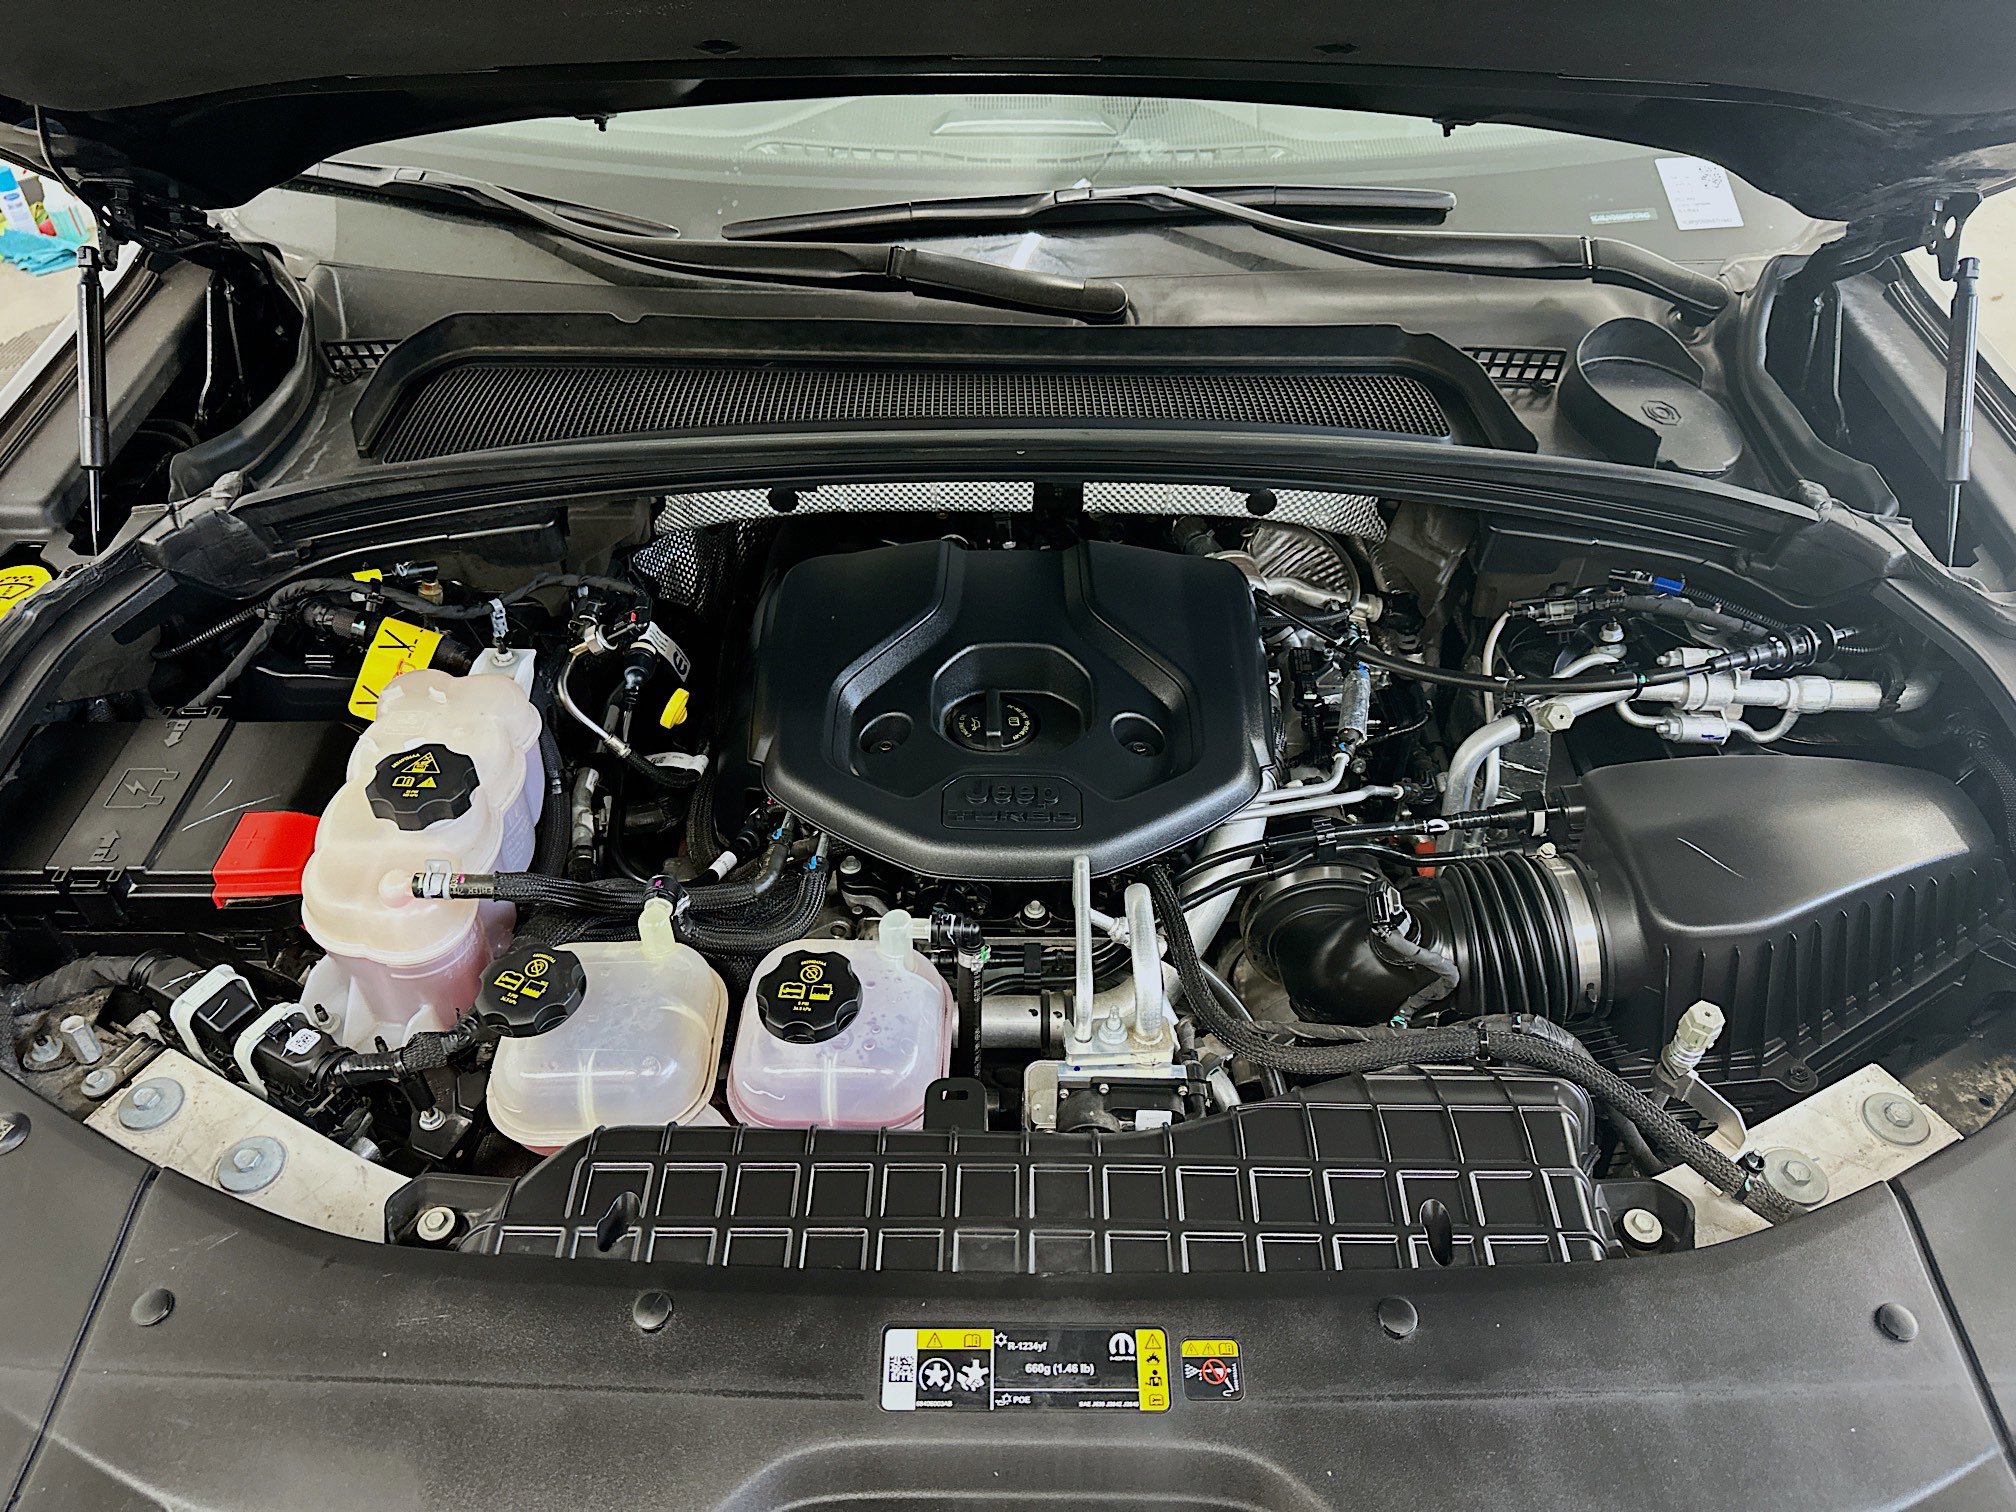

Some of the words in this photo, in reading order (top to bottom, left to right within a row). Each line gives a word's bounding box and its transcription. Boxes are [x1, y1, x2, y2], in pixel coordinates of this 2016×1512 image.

[965, 778, 1059, 810] Jeep
[947, 809, 1077, 823] TURBO
[1007, 1341, 1048, 1353] R-1234yf
[1025, 1364, 1052, 1376] 660g
[1079, 1364, 1095, 1376] lb)
[1012, 1395, 1031, 1404] POE
